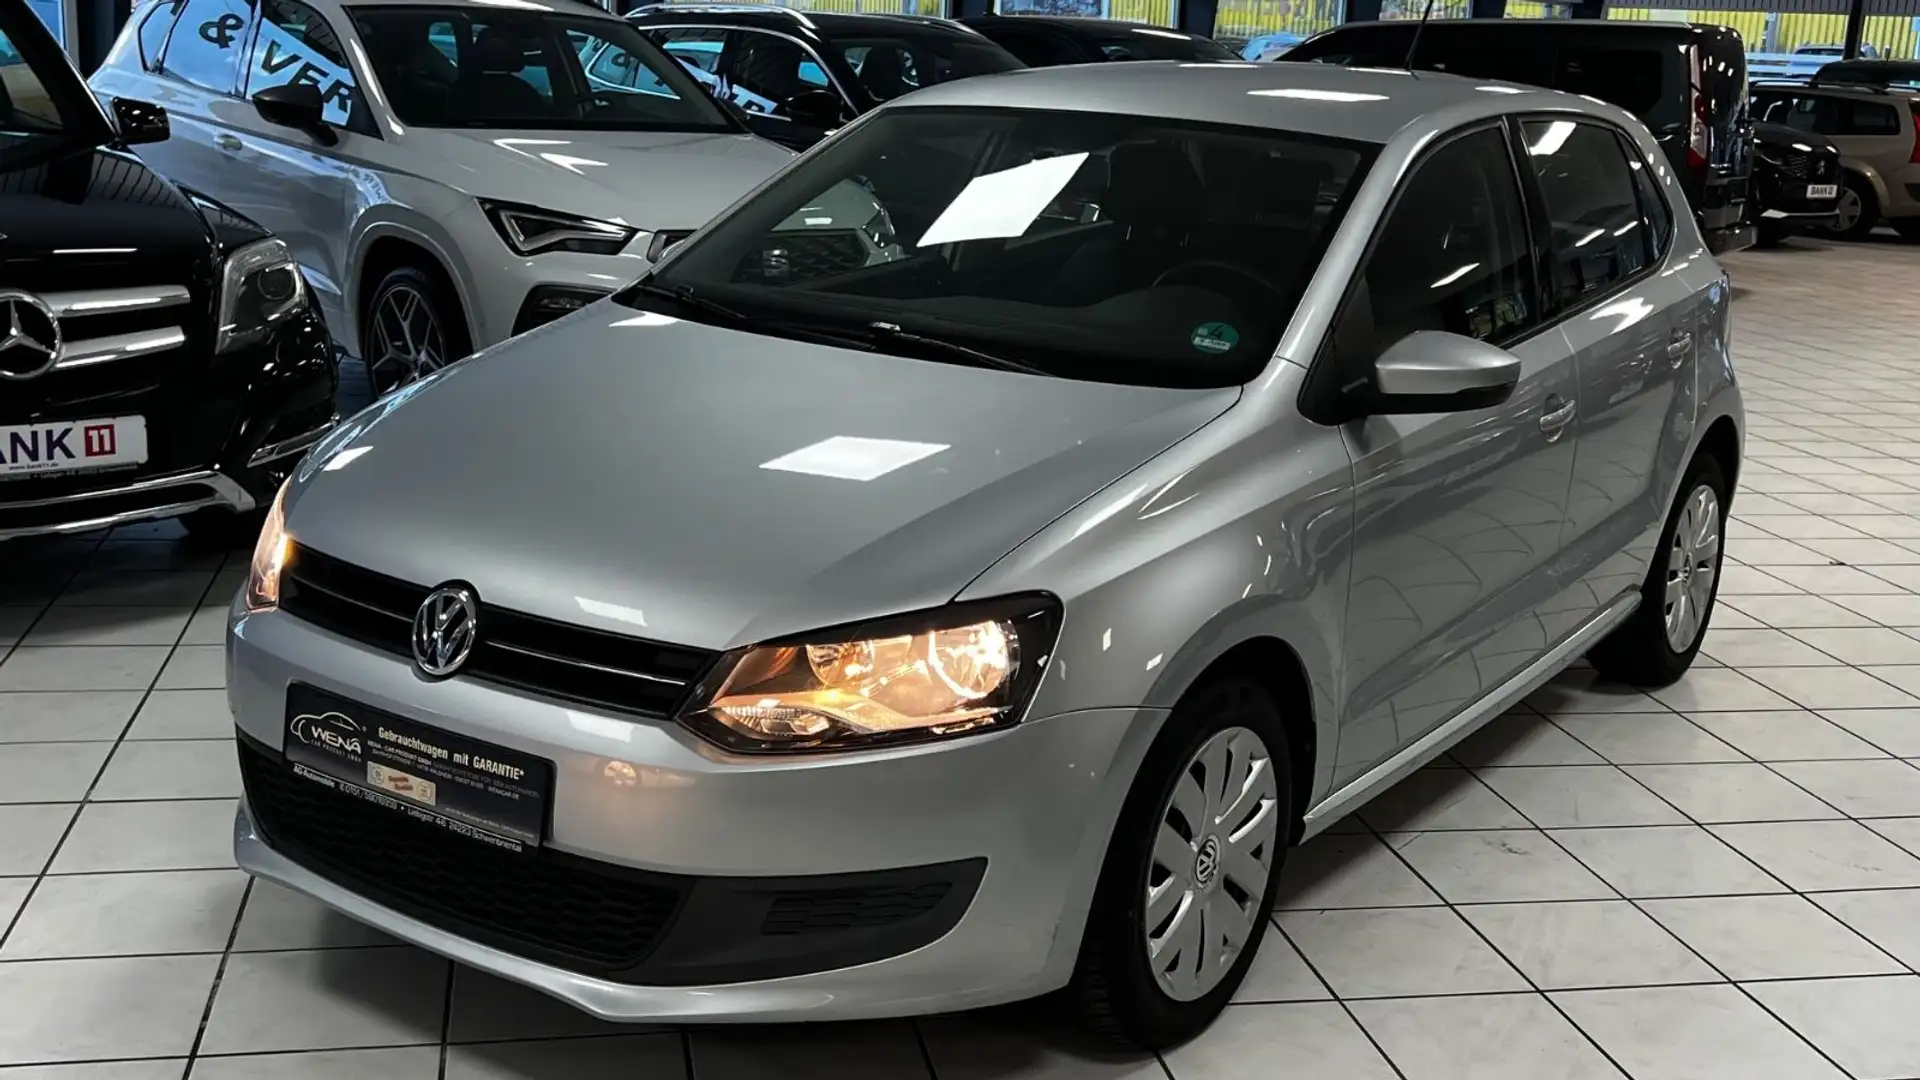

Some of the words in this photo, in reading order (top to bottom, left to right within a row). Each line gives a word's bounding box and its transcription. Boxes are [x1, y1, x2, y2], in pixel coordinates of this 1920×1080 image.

[88, 428, 112, 453] 11
[378, 726, 448, 760] Gebrauchtwagen
[453, 752, 469, 766] mit
